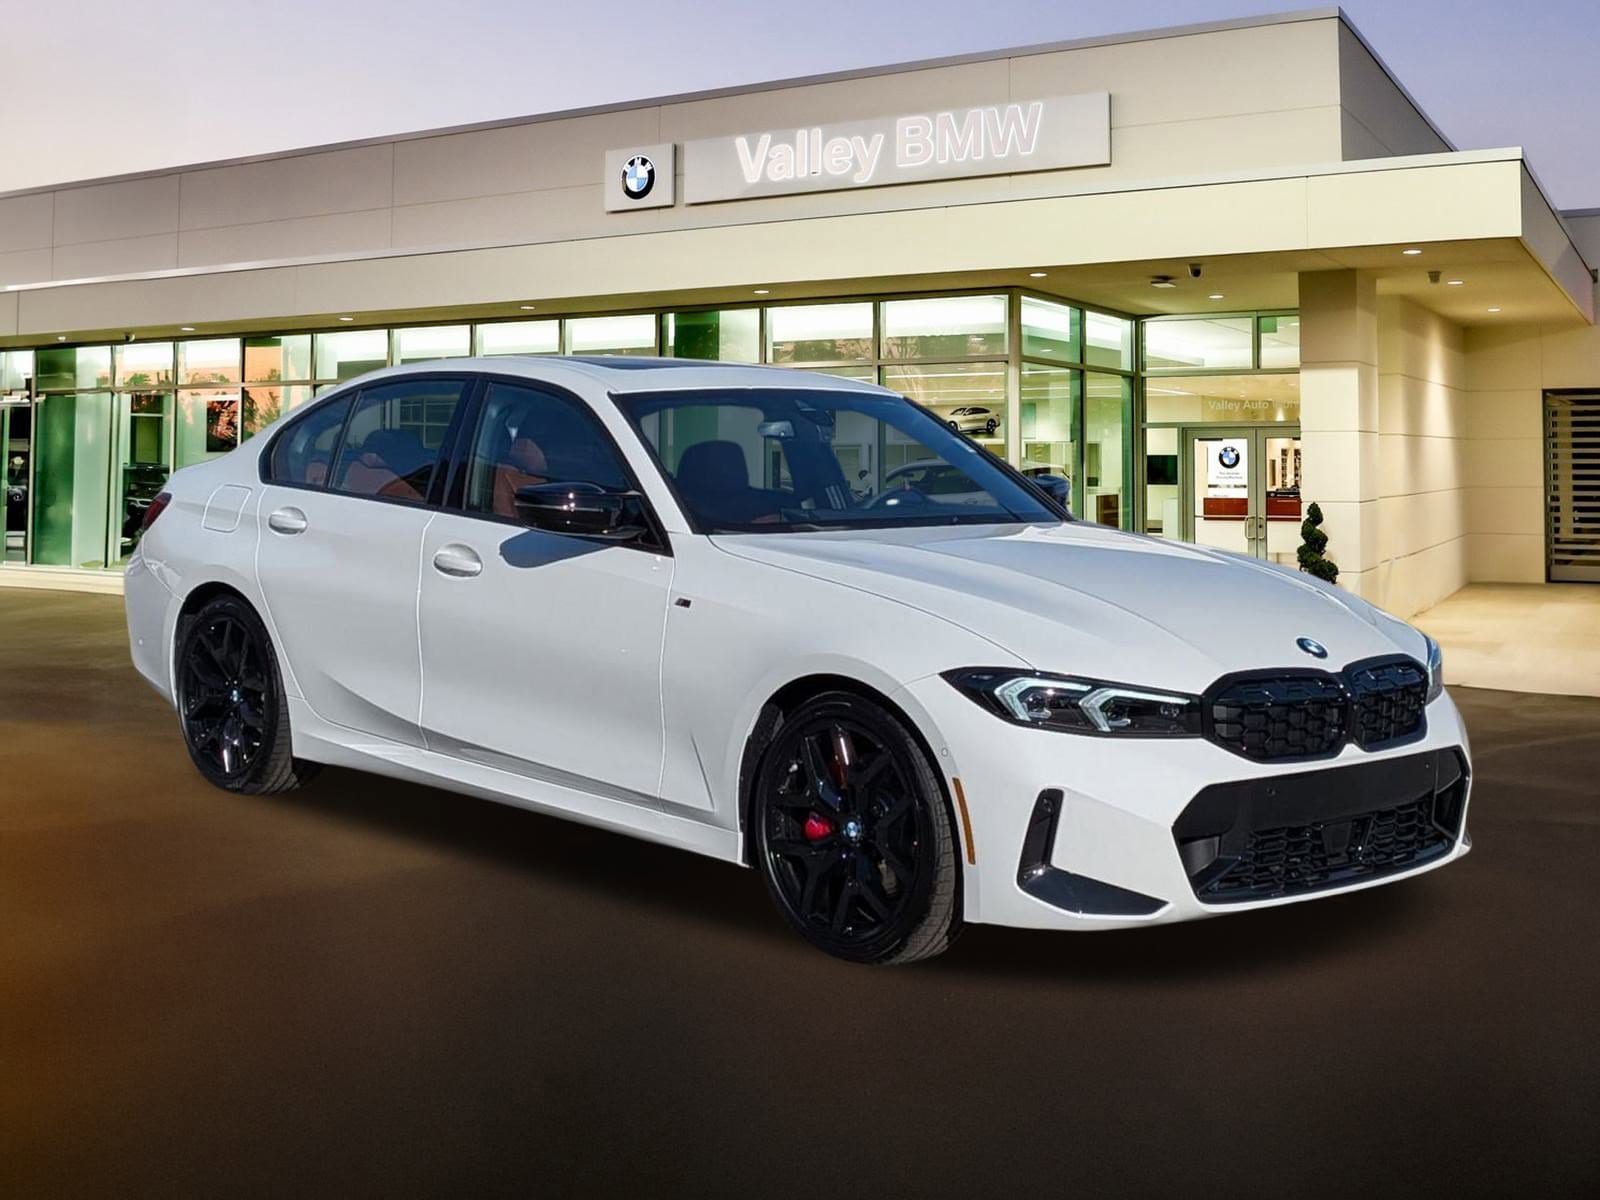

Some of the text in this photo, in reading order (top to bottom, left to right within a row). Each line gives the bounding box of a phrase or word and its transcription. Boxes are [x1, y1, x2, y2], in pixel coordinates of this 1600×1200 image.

[735, 102, 1044, 183] Valley BMW
[1208, 399, 1241, 412] Valley
[1243, 400, 1270, 409] Auto
